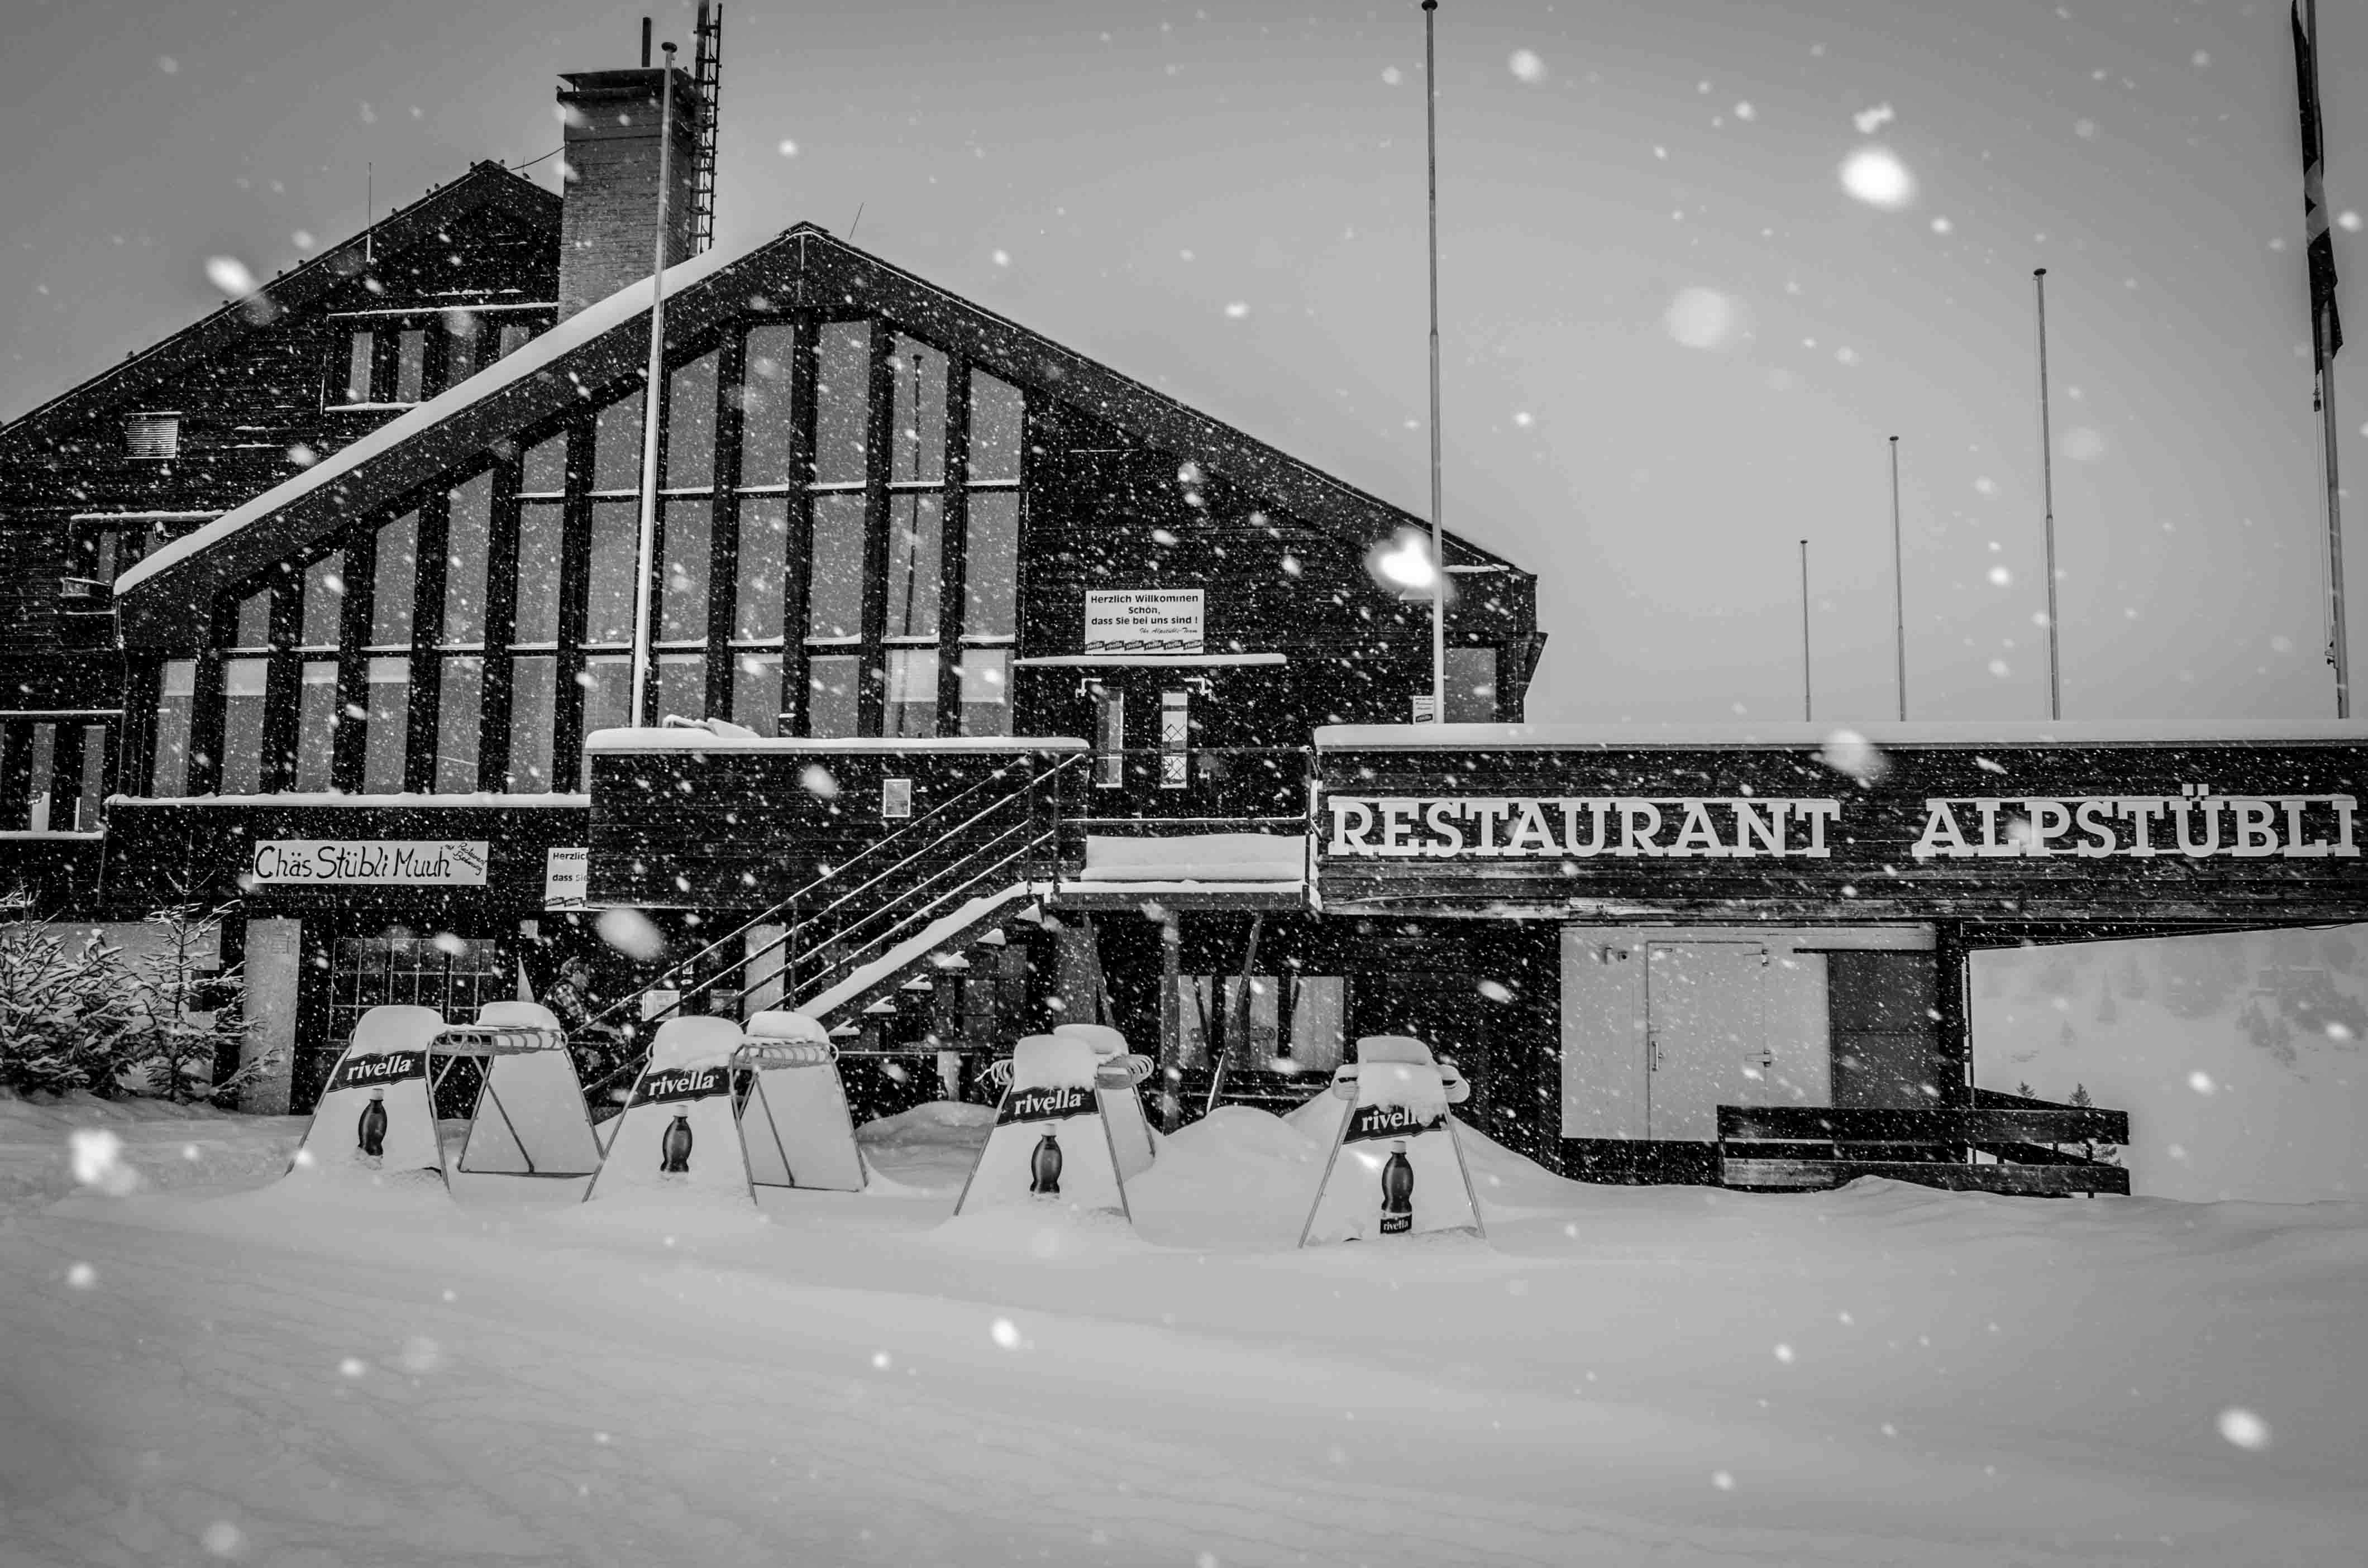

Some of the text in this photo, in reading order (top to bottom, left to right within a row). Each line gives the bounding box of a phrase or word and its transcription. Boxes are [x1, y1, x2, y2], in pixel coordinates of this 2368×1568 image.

[1091, 594, 1199, 603] Herzlich Willkommen
[1128, 606, 1161, 615] Schön,
[1328, 783, 2360, 858] RESTAURANT ALPSTÜBLI
[255, 845, 451, 879] Chäs Stübli Muuh
[346, 1055, 412, 1081] rivella
[648, 1072, 715, 1096] rivella
[1014, 1089, 1081, 1115] rivella
[1361, 1106, 1420, 1132] rivell
[1383, 1220, 1409, 1231] rivella
